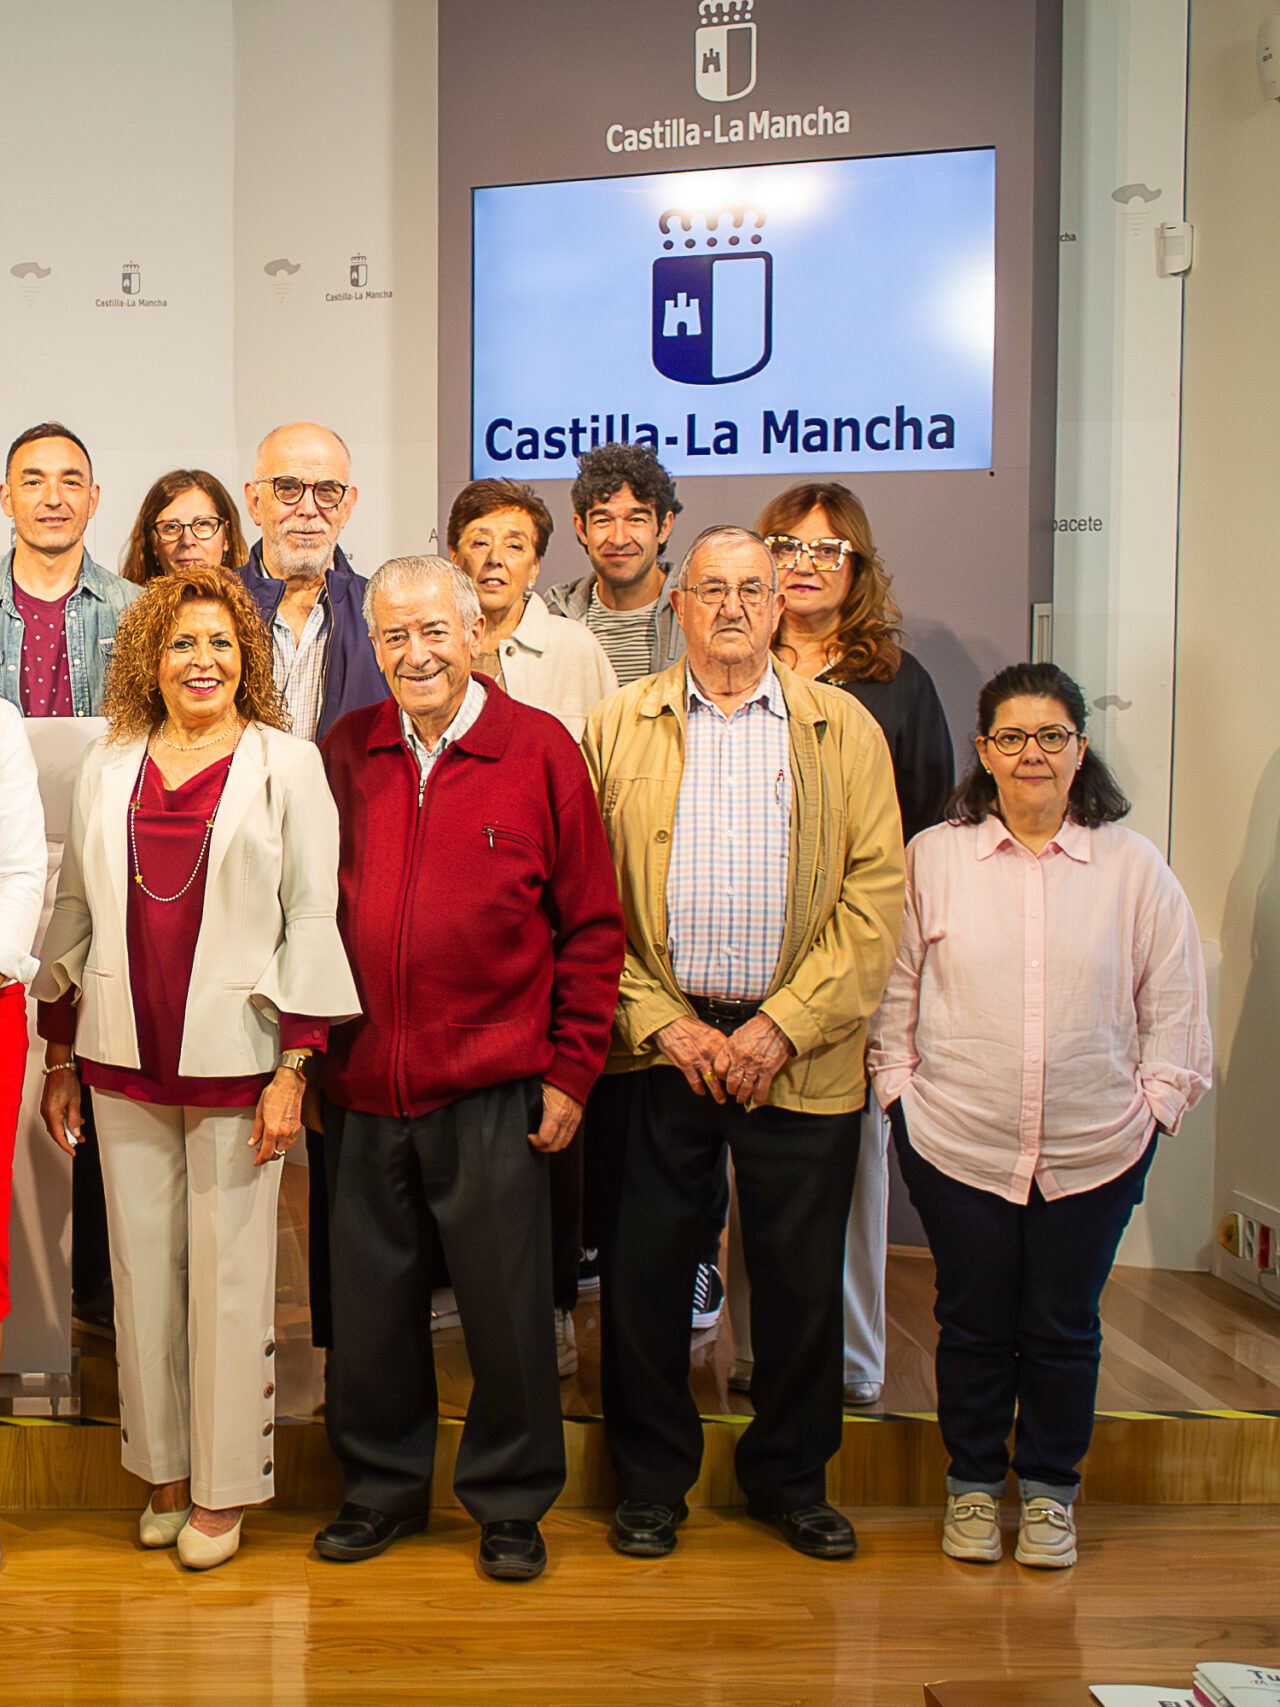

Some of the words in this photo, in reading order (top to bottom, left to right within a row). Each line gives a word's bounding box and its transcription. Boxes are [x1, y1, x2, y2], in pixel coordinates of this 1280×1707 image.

[606, 114, 744, 153] Castilla-La
[748, 105, 850, 141] Mancha
[138, 298, 167, 307] Mancha
[365, 290, 393, 300] Mancha
[485, 413, 739, 462] Castilla-La
[762, 405, 956, 455] Mancha
